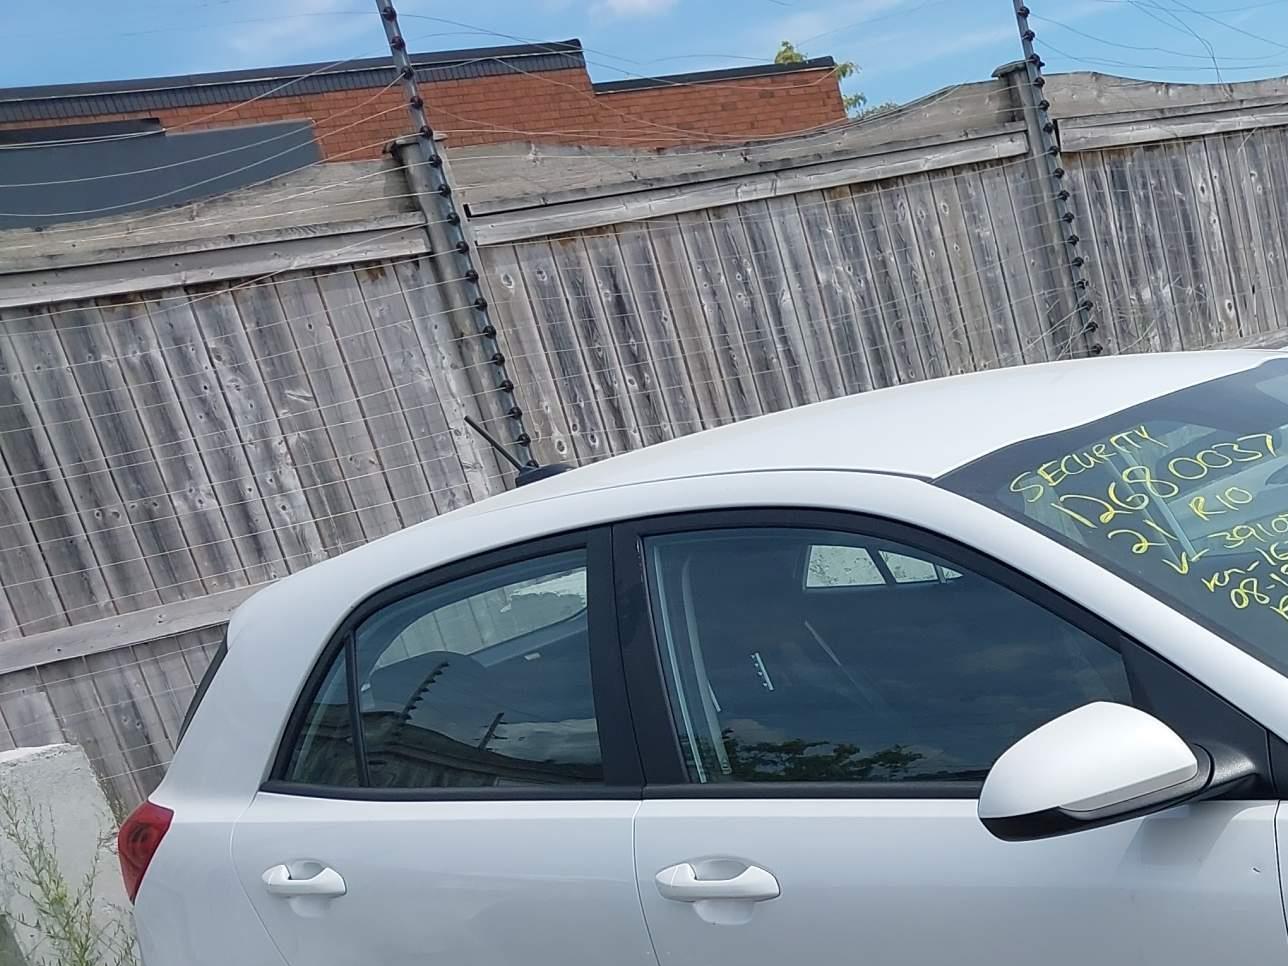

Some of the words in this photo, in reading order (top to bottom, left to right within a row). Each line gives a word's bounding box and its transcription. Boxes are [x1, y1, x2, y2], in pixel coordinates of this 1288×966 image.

[1009, 425, 1169, 502] SECURITY
[1051, 433, 1278, 529] 12680037
[1107, 518, 1178, 554] 21
[1188, 487, 1253, 521] RIO
